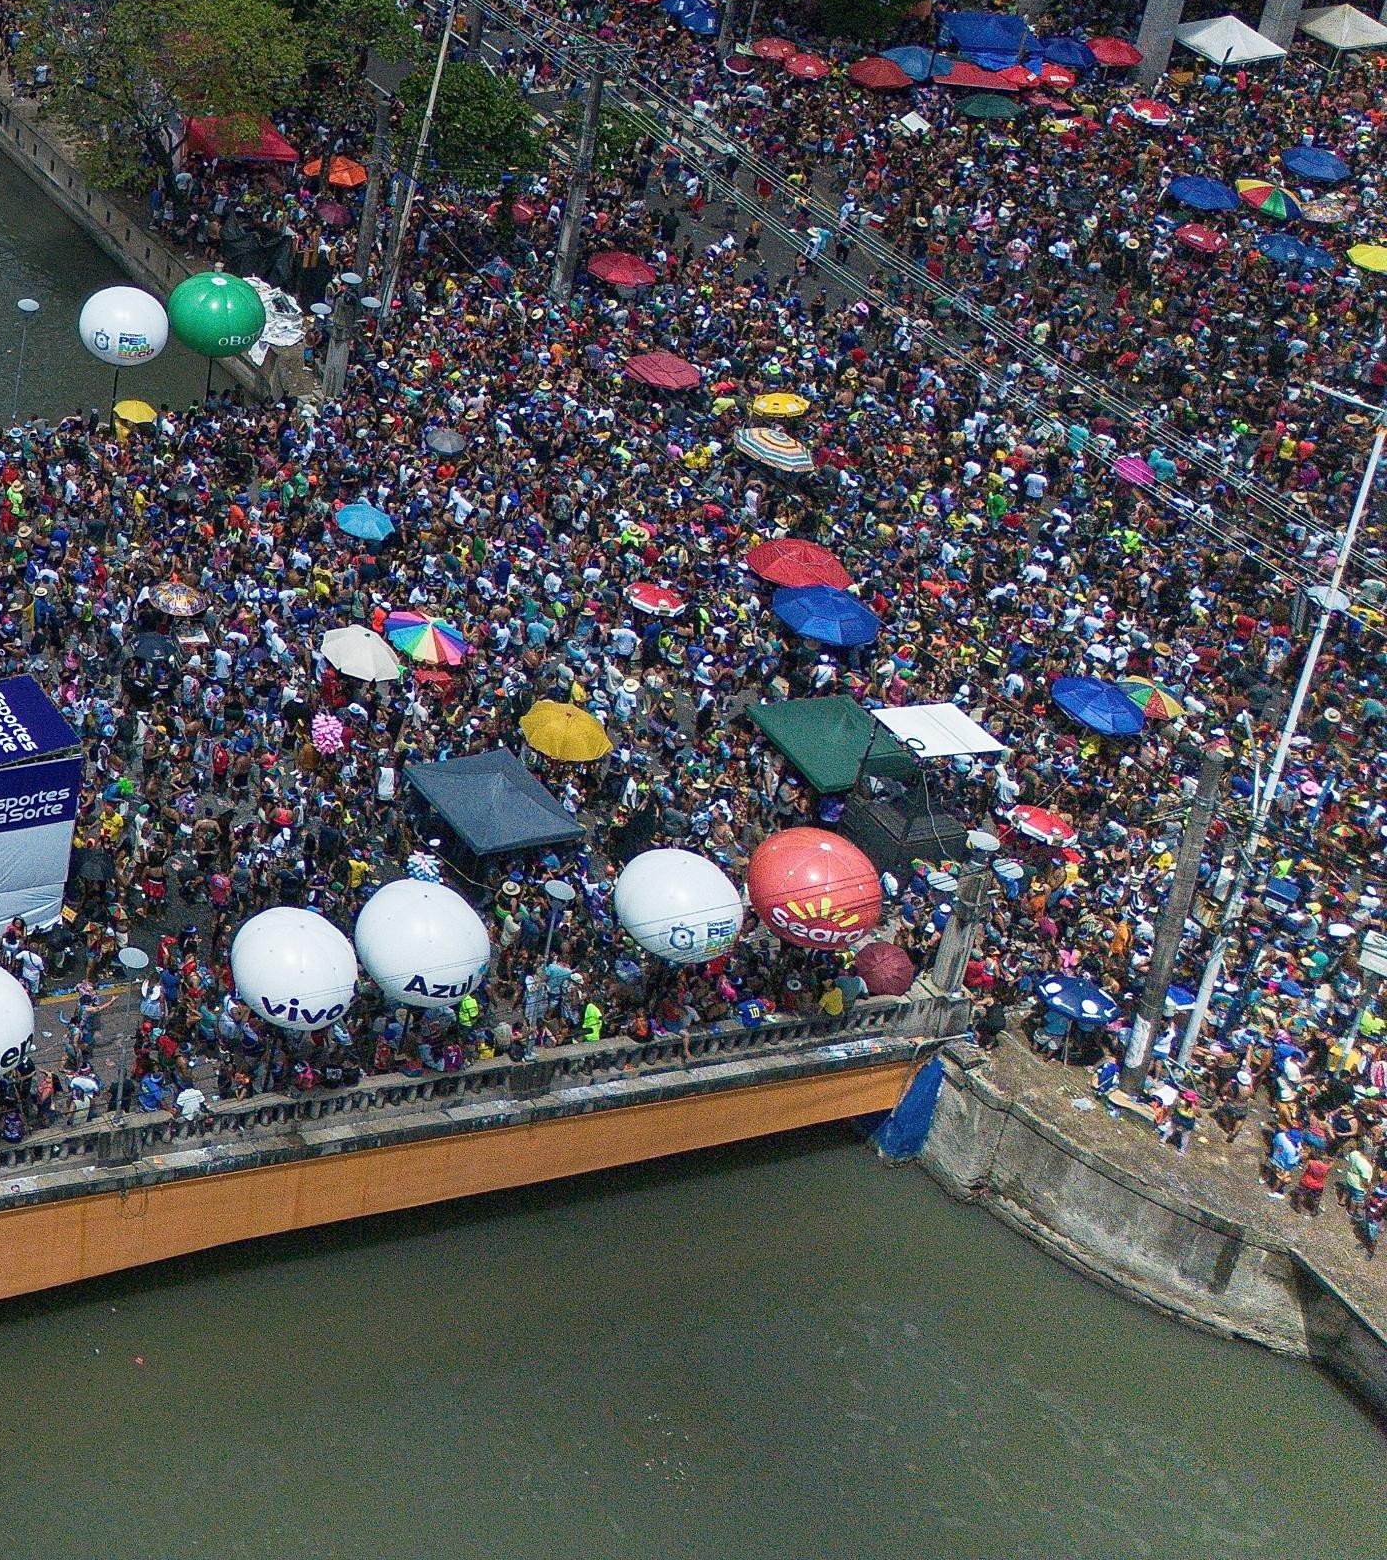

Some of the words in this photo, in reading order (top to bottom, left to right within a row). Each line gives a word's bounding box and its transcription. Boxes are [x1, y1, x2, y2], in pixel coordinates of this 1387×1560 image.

[118, 337, 146, 349] PER
[8, 801, 63, 824] Sorte
[773, 904, 864, 944] Seara
[403, 971, 476, 998] Azul
[262, 996, 345, 1026] vivo
